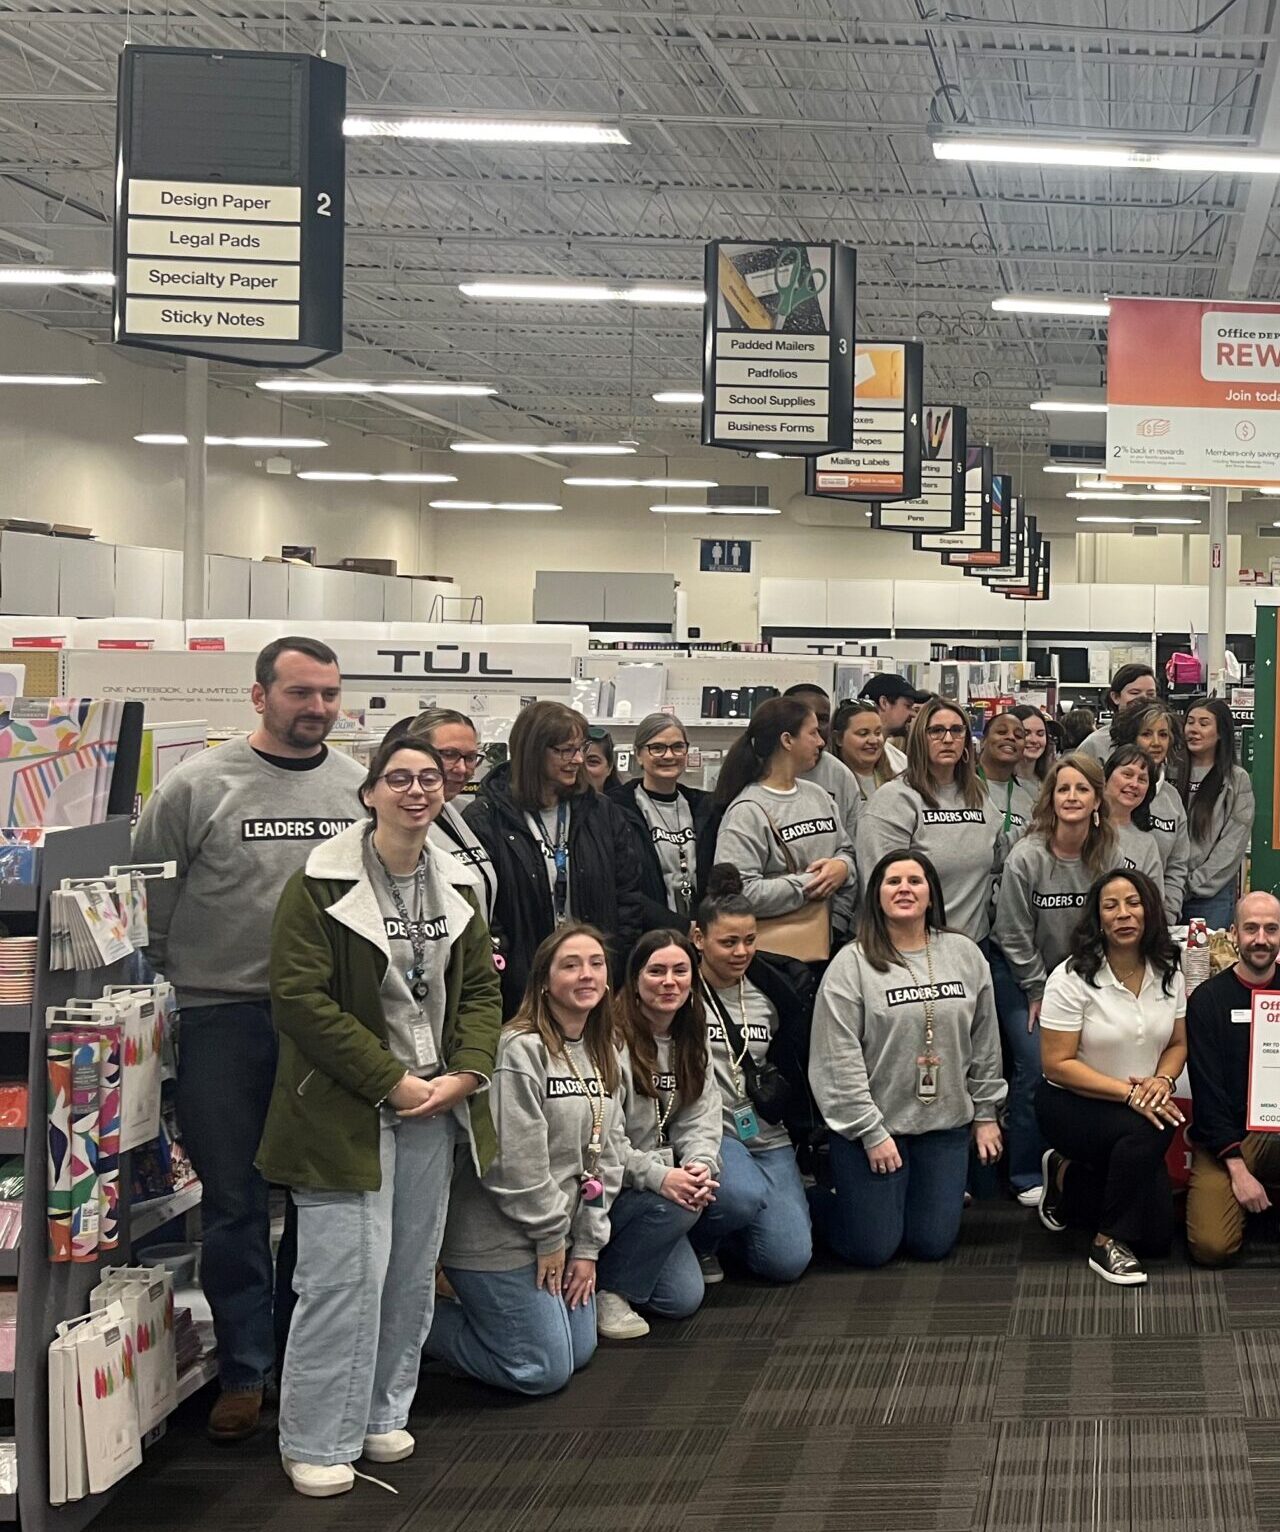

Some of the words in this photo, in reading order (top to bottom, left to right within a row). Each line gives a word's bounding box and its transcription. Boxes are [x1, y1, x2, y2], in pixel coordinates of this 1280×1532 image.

[161, 191, 217, 209] Design
[223, 194, 271, 211] Paper
[317, 192, 331, 217] 2
[170, 231, 214, 247] Legal
[219, 233, 260, 248] Pads
[149, 269, 225, 289] Specialty
[230, 274, 278, 289] Paper
[161, 309, 212, 327] Sticky
[217, 312, 265, 326] Notes
[1217, 328, 1256, 339] Office
[731, 339, 773, 351] Padded
[776, 340, 815, 352] Mailers
[839, 338, 848, 354] 3
[748, 368, 798, 379] Padfolios
[729, 395, 766, 406] School
[769, 395, 816, 407] Supplies
[1225, 389, 1251, 401] Join
[853, 416, 874, 424] oxes
[910, 413, 917, 426] 4
[728, 421, 777, 432] Business
[780, 423, 815, 433] Forms
[831, 457, 861, 467] Mailing
[863, 457, 890, 467] Labels
[957, 462, 962, 473] 5
[923, 810, 963, 823] LEADERS
[245, 820, 315, 838] LEADERS
[1154, 818, 1175, 831] ONLY
[1033, 894, 1073, 907] LEADERS
[888, 985, 940, 1005] LEADERS
